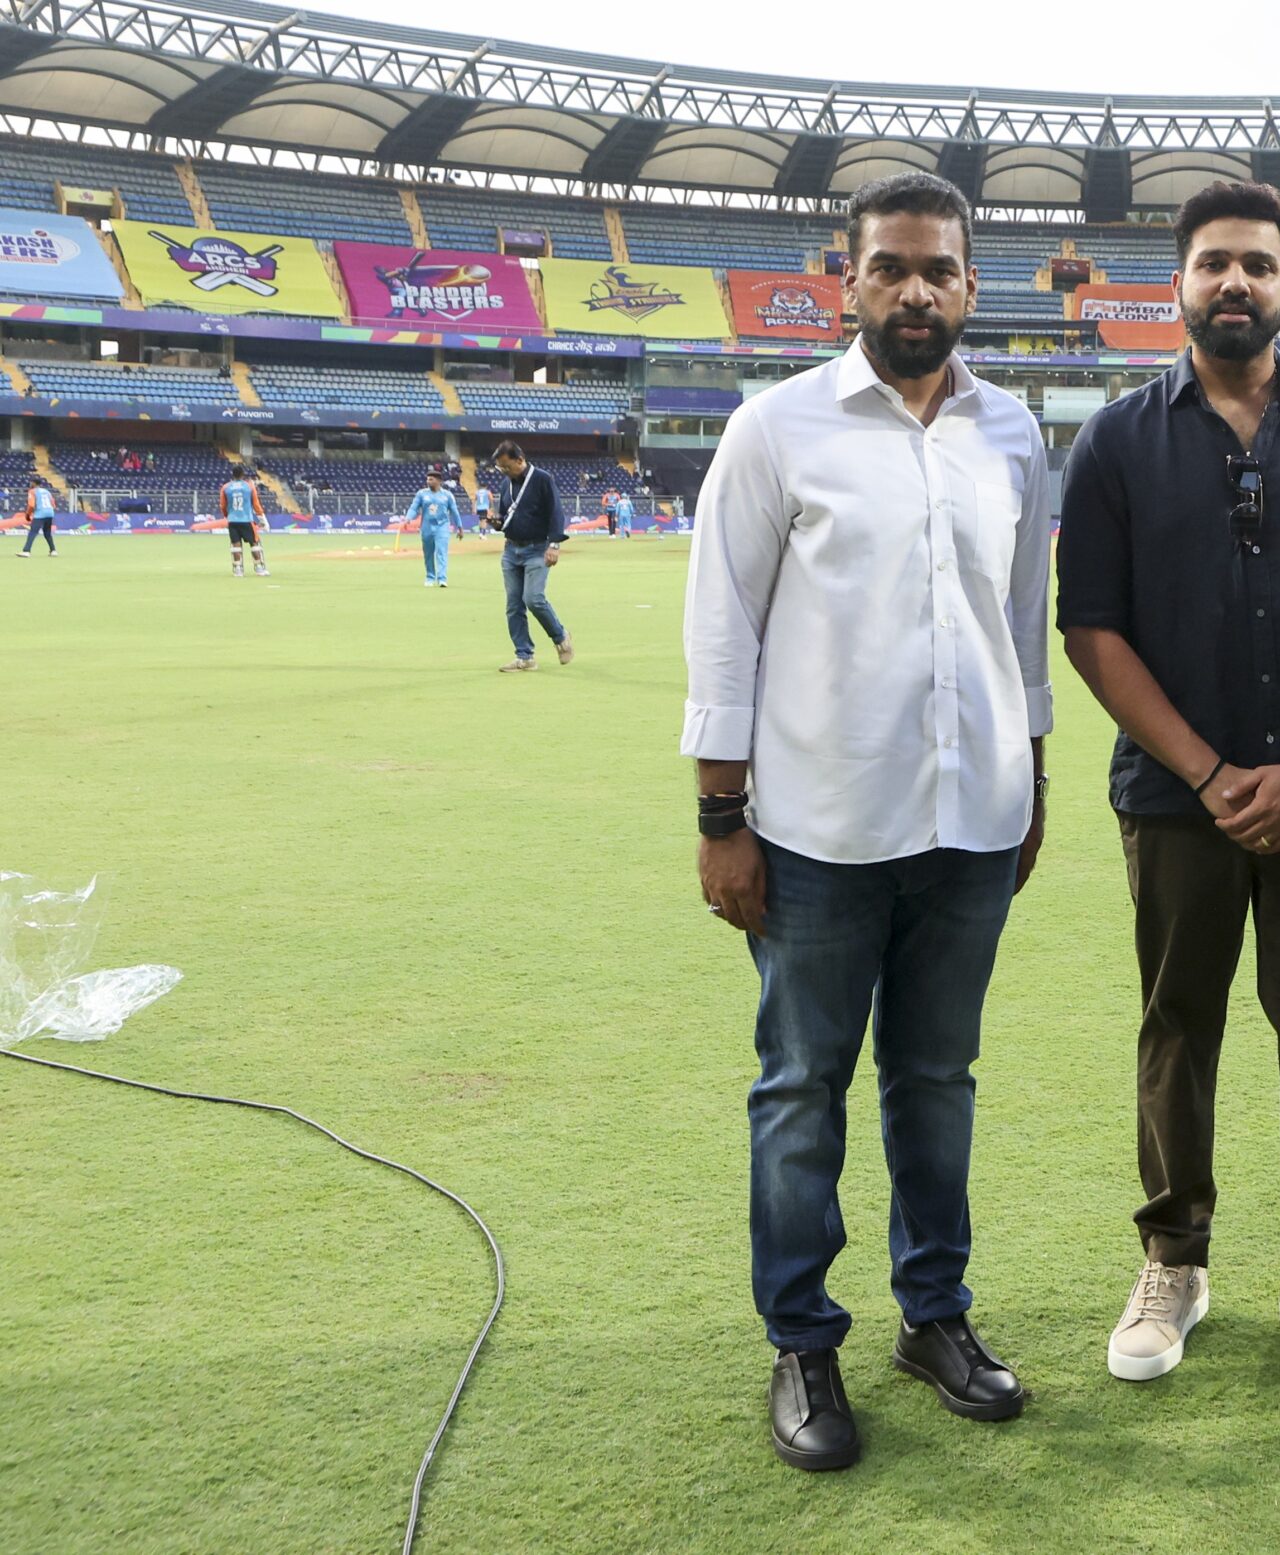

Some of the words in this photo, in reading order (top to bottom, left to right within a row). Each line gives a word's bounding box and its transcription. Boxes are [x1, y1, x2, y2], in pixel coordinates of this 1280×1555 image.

[0, 235, 54, 248] KASH
[188, 252, 262, 269] ARCS
[406, 284, 488, 297] BANDRA
[390, 295, 504, 310] BLASTERS
[765, 317, 829, 329] ROYALS
[1084, 312, 1159, 321] FALCONS
[237, 410, 274, 419] nuvama
